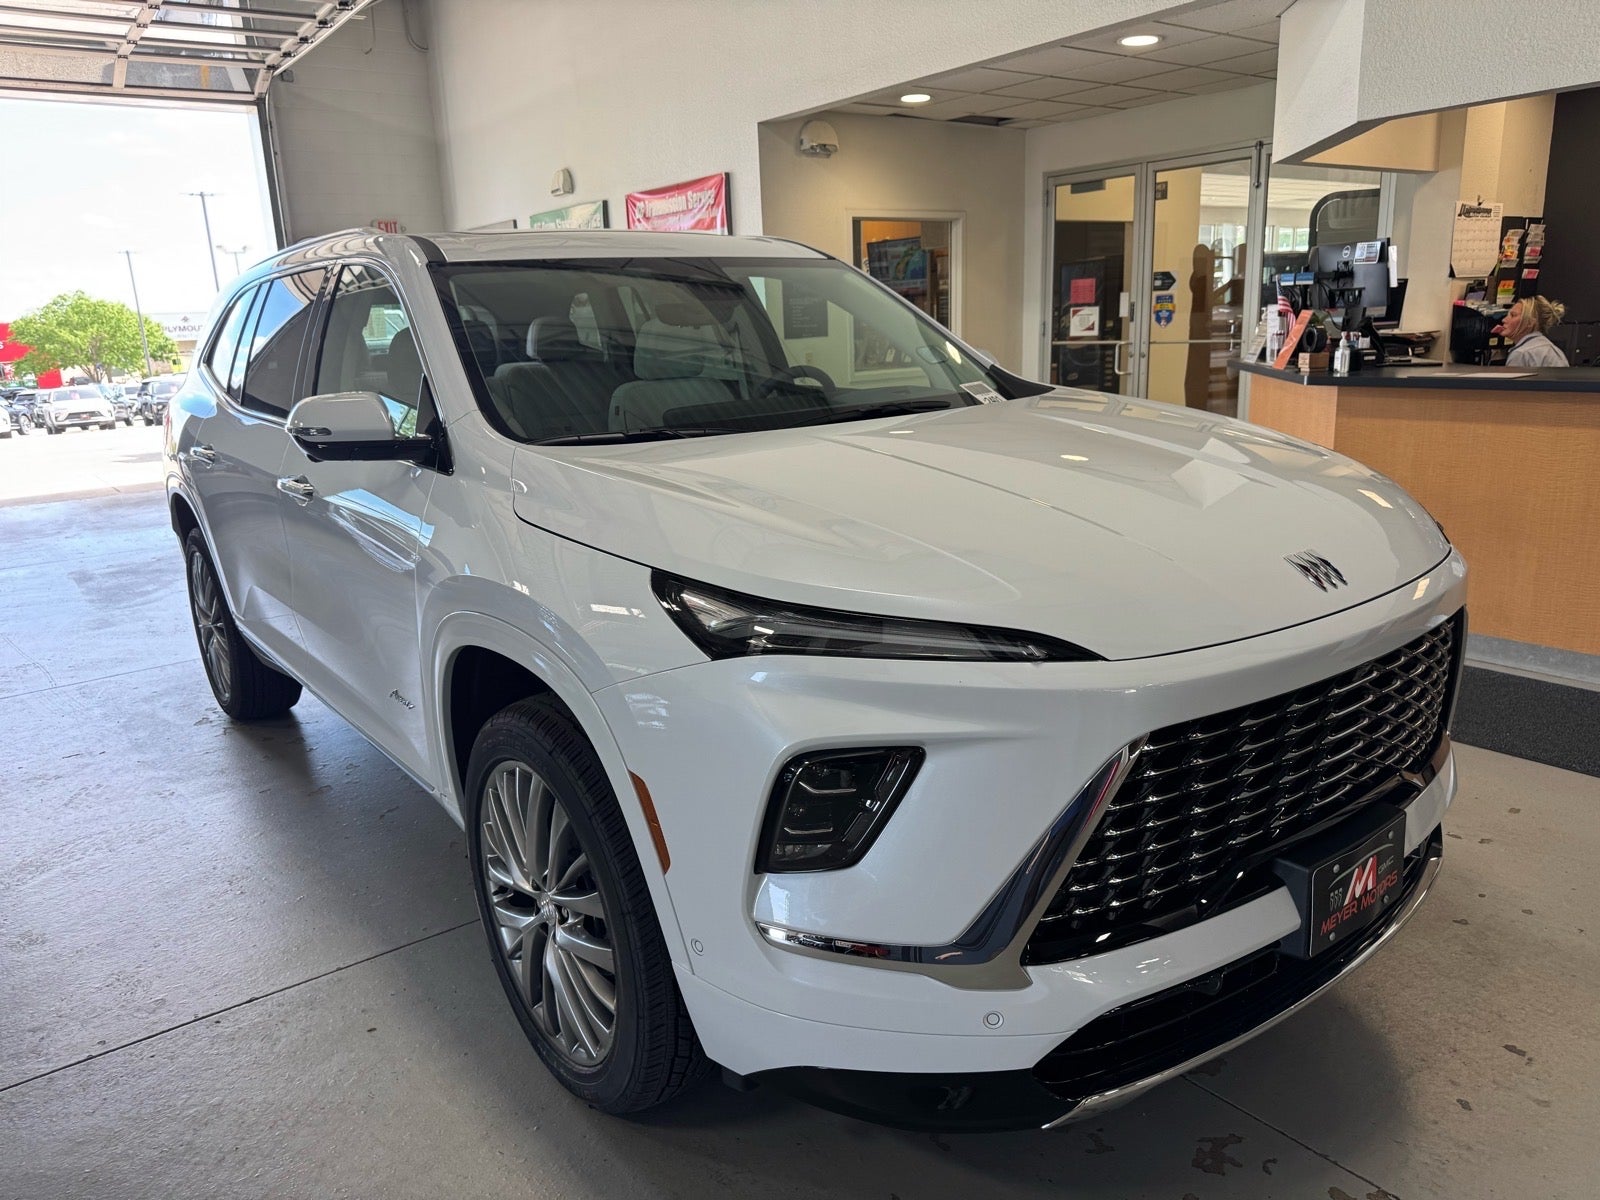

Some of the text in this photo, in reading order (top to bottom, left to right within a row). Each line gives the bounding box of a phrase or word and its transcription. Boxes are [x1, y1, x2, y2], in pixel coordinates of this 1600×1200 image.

[687, 188, 715, 210] Service
[377, 219, 397, 234] EXIT
[1320, 870, 1398, 936] MEYER MOTORS
